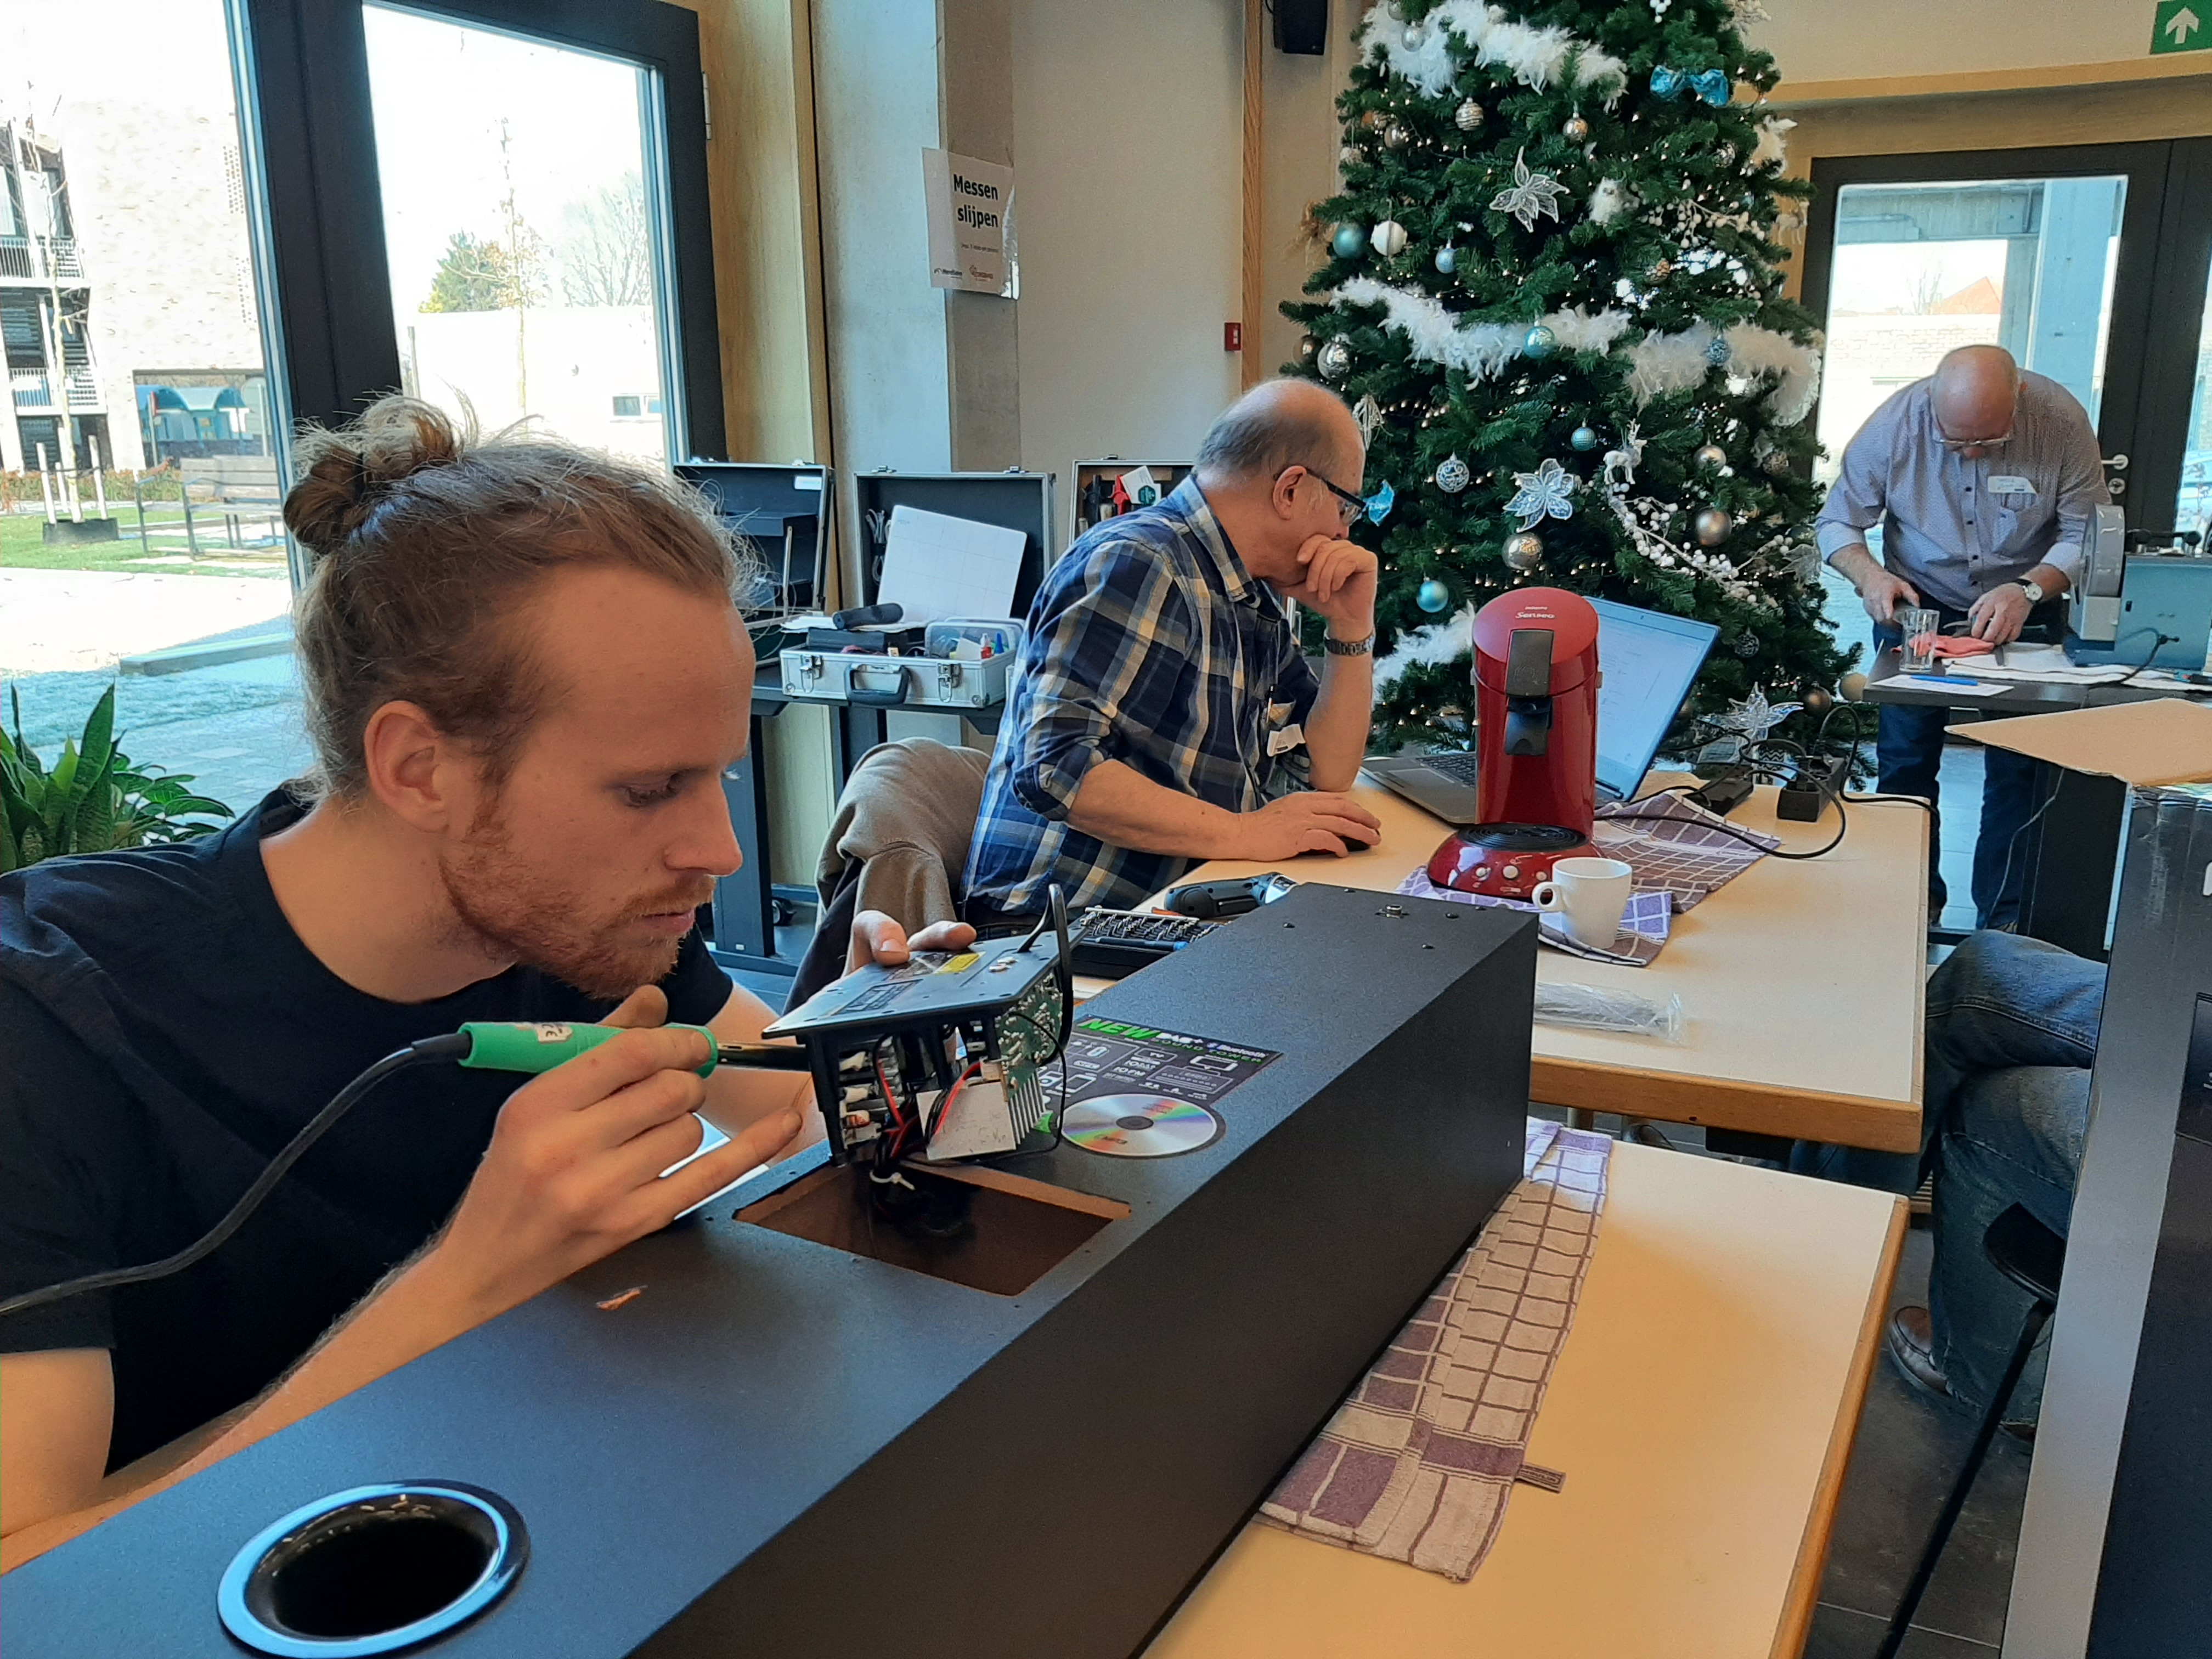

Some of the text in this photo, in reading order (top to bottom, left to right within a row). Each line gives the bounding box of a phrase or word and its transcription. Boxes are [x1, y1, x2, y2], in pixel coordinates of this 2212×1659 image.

[953, 173, 998, 201] Messen
[957, 204, 998, 229] slijpen
[1077, 1018, 1161, 1040] NEW
[1151, 1037, 1204, 1051] SOUND
[1209, 1048, 1262, 1063] TOWER
